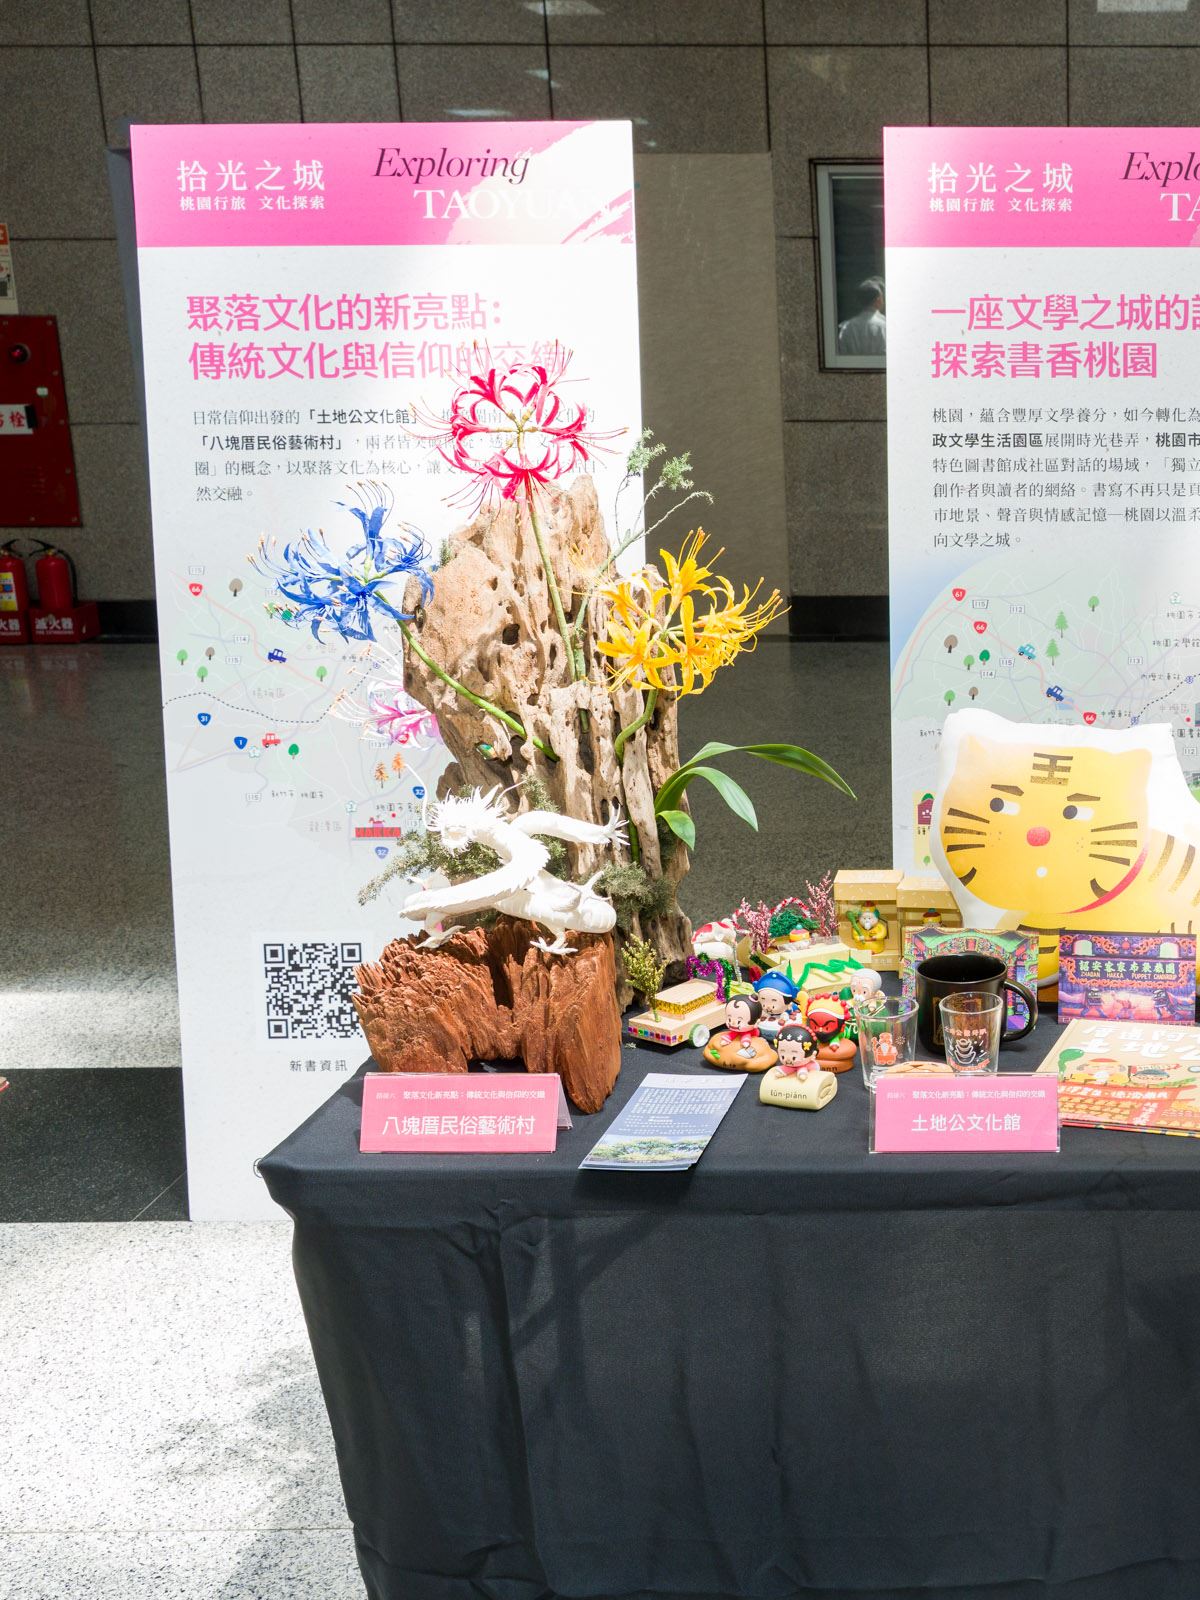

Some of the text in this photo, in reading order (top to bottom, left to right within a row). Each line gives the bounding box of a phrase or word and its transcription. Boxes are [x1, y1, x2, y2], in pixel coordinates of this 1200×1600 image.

[373, 146, 531, 185] Exploring
[177, 158, 326, 193] 拾光之城
[927, 161, 1075, 195] 拾光之城
[179, 194, 326, 212] 桃園行旅 文化探索
[928, 197, 1074, 213] 桃園行旅 文化探索
[930, 341, 1159, 380] 探索書香桃園
[196, 485, 254, 502] 然交融。
[933, 532, 1022, 548] 向文學之城。
[955, 590, 964, 598] 61
[974, 600, 987, 608] 115
[1010, 605, 1024, 613] 112
[976, 623, 985, 631] 66
[1001, 659, 1013, 667] 115
[982, 670, 994, 678] 114
[1086, 714, 1095, 722] 66
[289, 1059, 349, 1073] 新書資訊
[911, 1113, 1022, 1132] 土地公文化館
